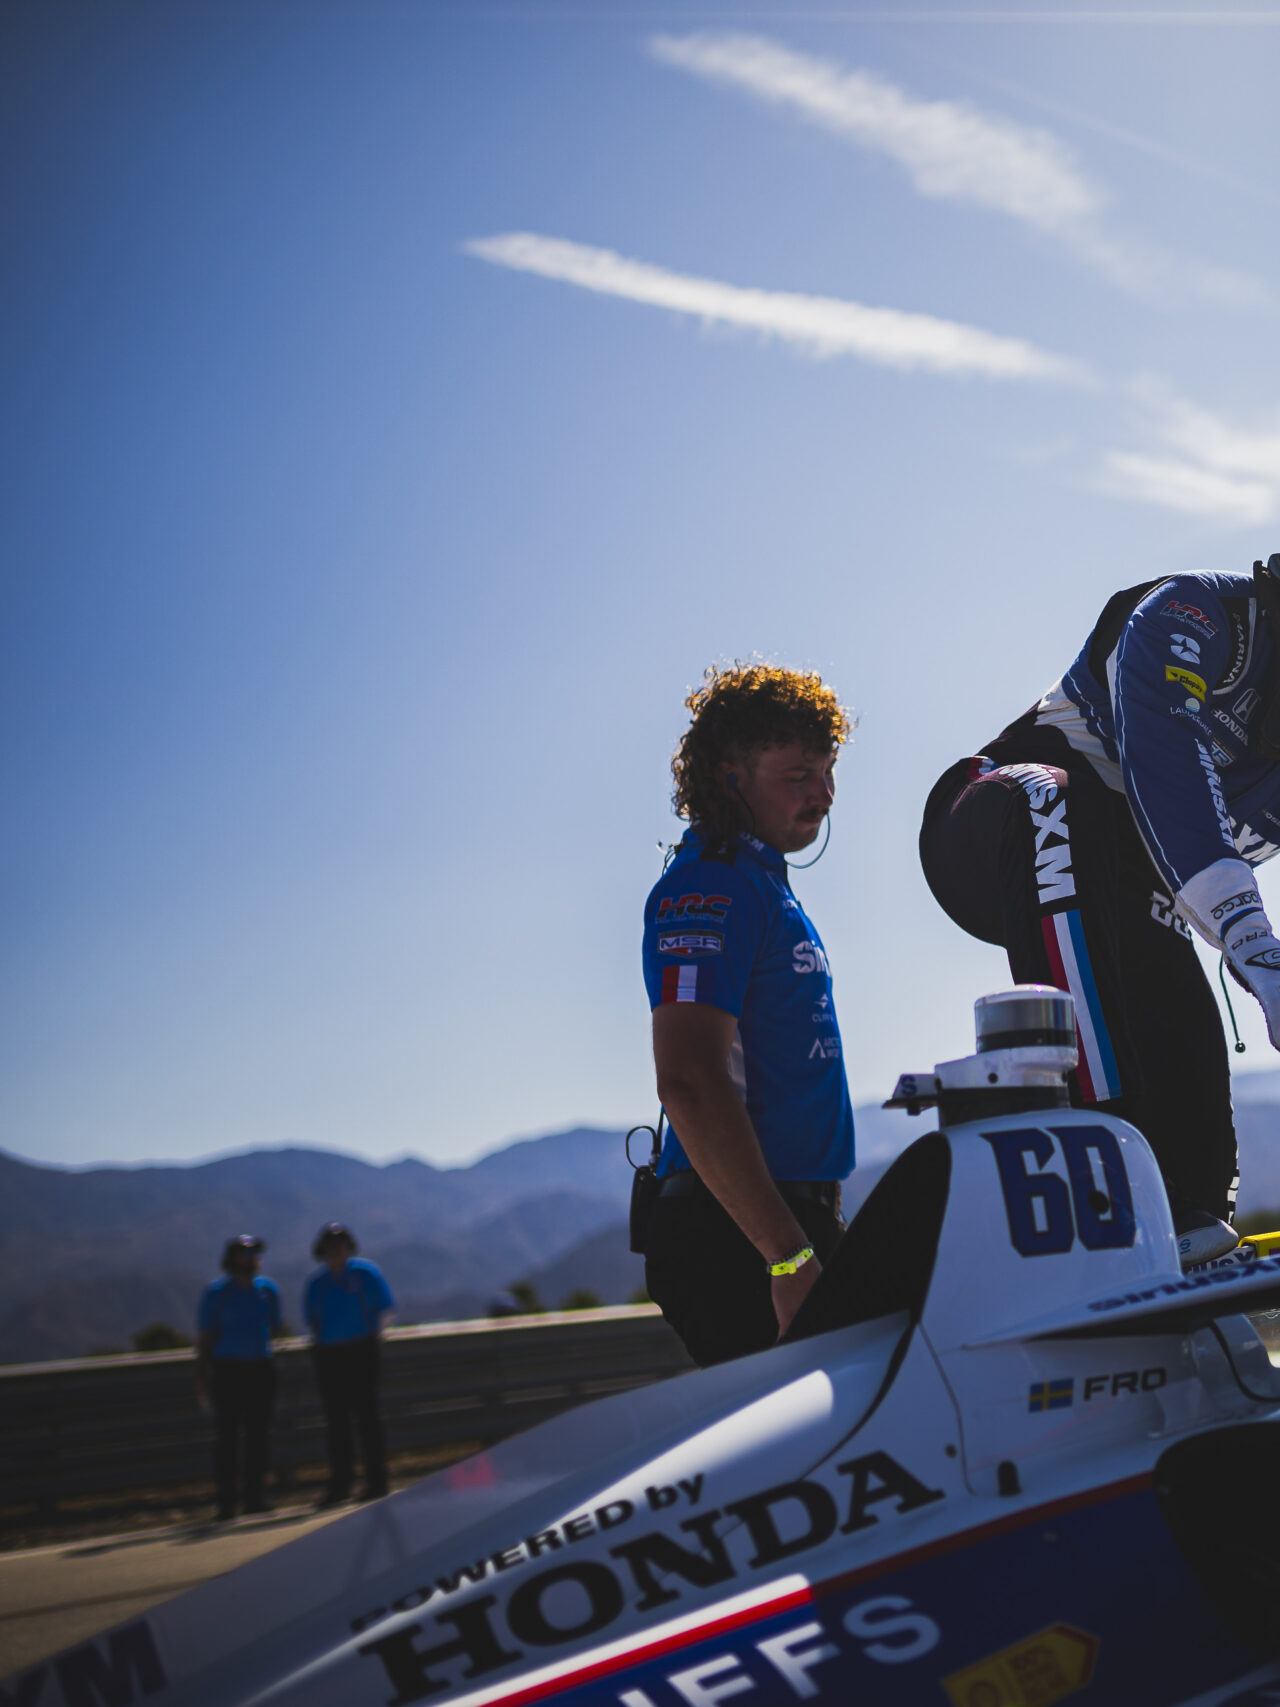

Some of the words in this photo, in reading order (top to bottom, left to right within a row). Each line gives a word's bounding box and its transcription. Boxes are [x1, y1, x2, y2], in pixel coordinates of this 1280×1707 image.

[1210, 709, 1249, 747] HONDA
[656, 892, 732, 920] HRC
[661, 936, 721, 949] MSR
[979, 1125, 1137, 1258] 60
[1083, 1367, 1167, 1401] FRO
[350, 1499, 635, 1635] POWERED
[645, 1473, 704, 1511] by
[358, 1450, 946, 1707] HONDA
[617, 1593, 942, 1707] FFS
